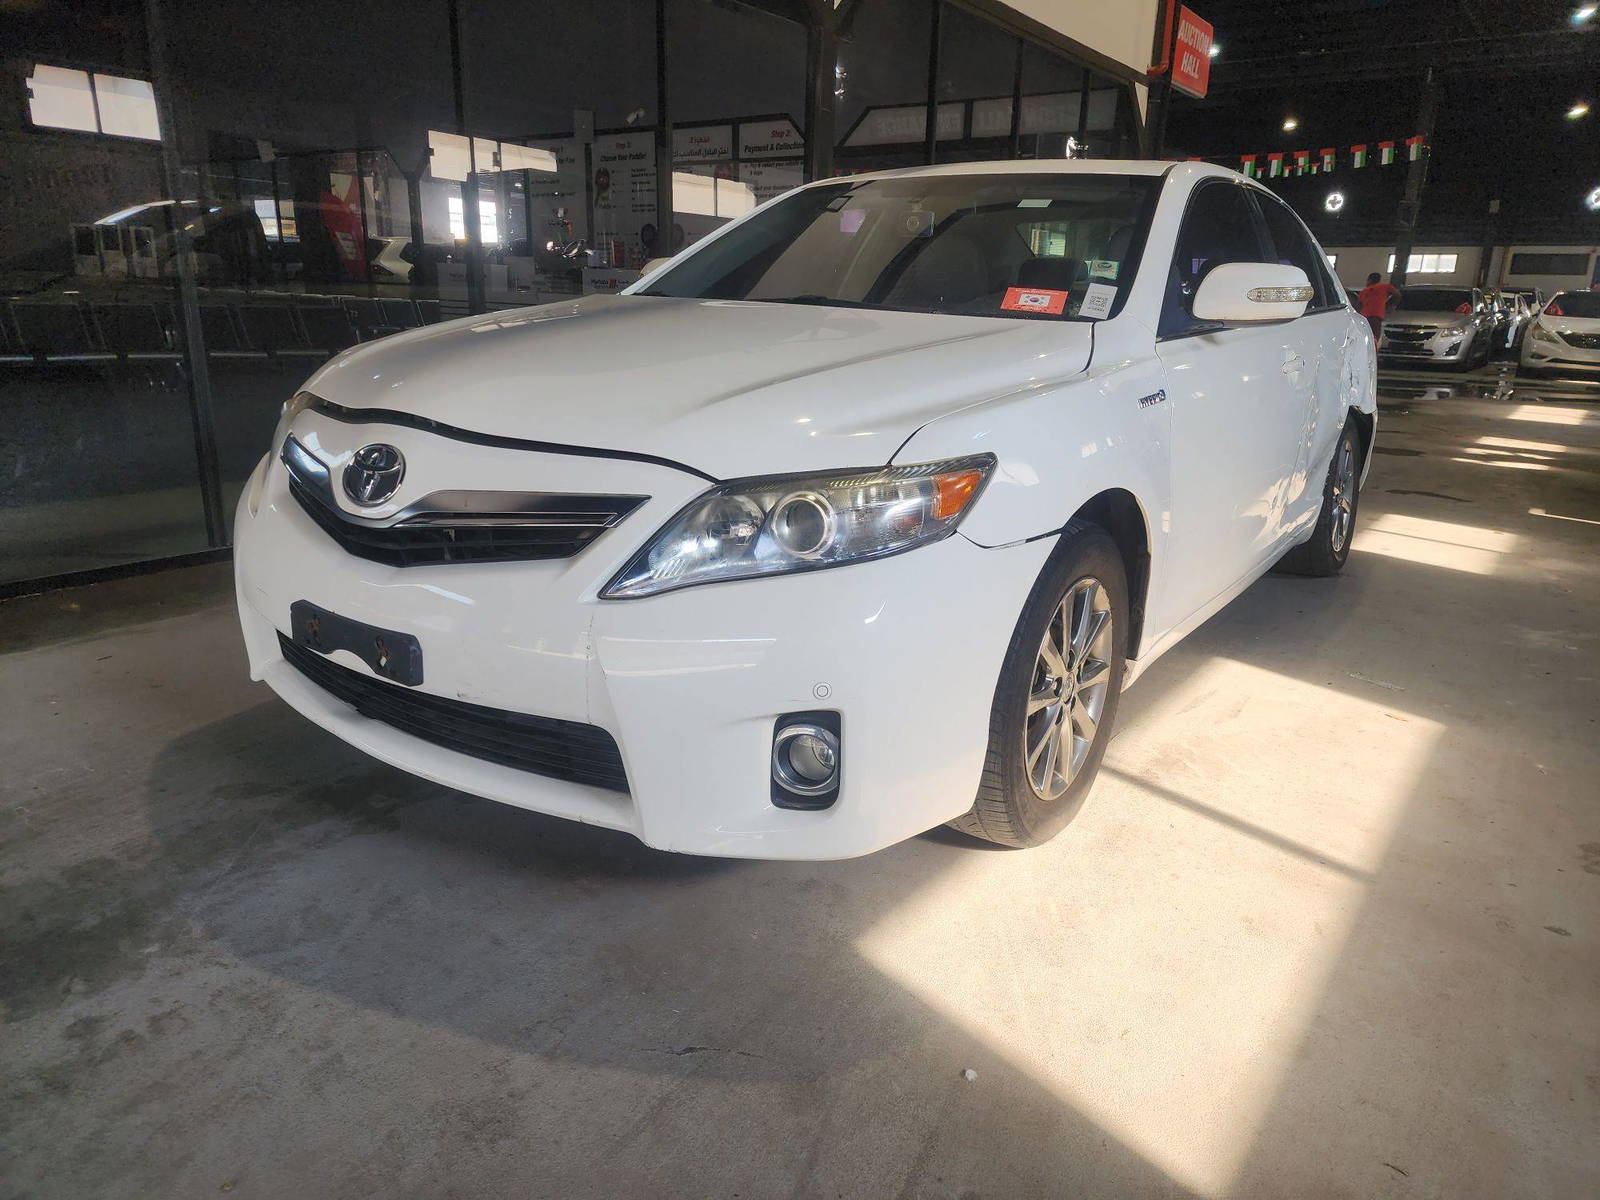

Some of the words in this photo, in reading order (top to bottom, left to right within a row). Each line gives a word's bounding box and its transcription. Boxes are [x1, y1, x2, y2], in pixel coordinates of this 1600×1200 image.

[1178, 19, 1210, 56] AUCTION
[1181, 51, 1200, 79] HALL
[744, 143, 769, 154] Payment
